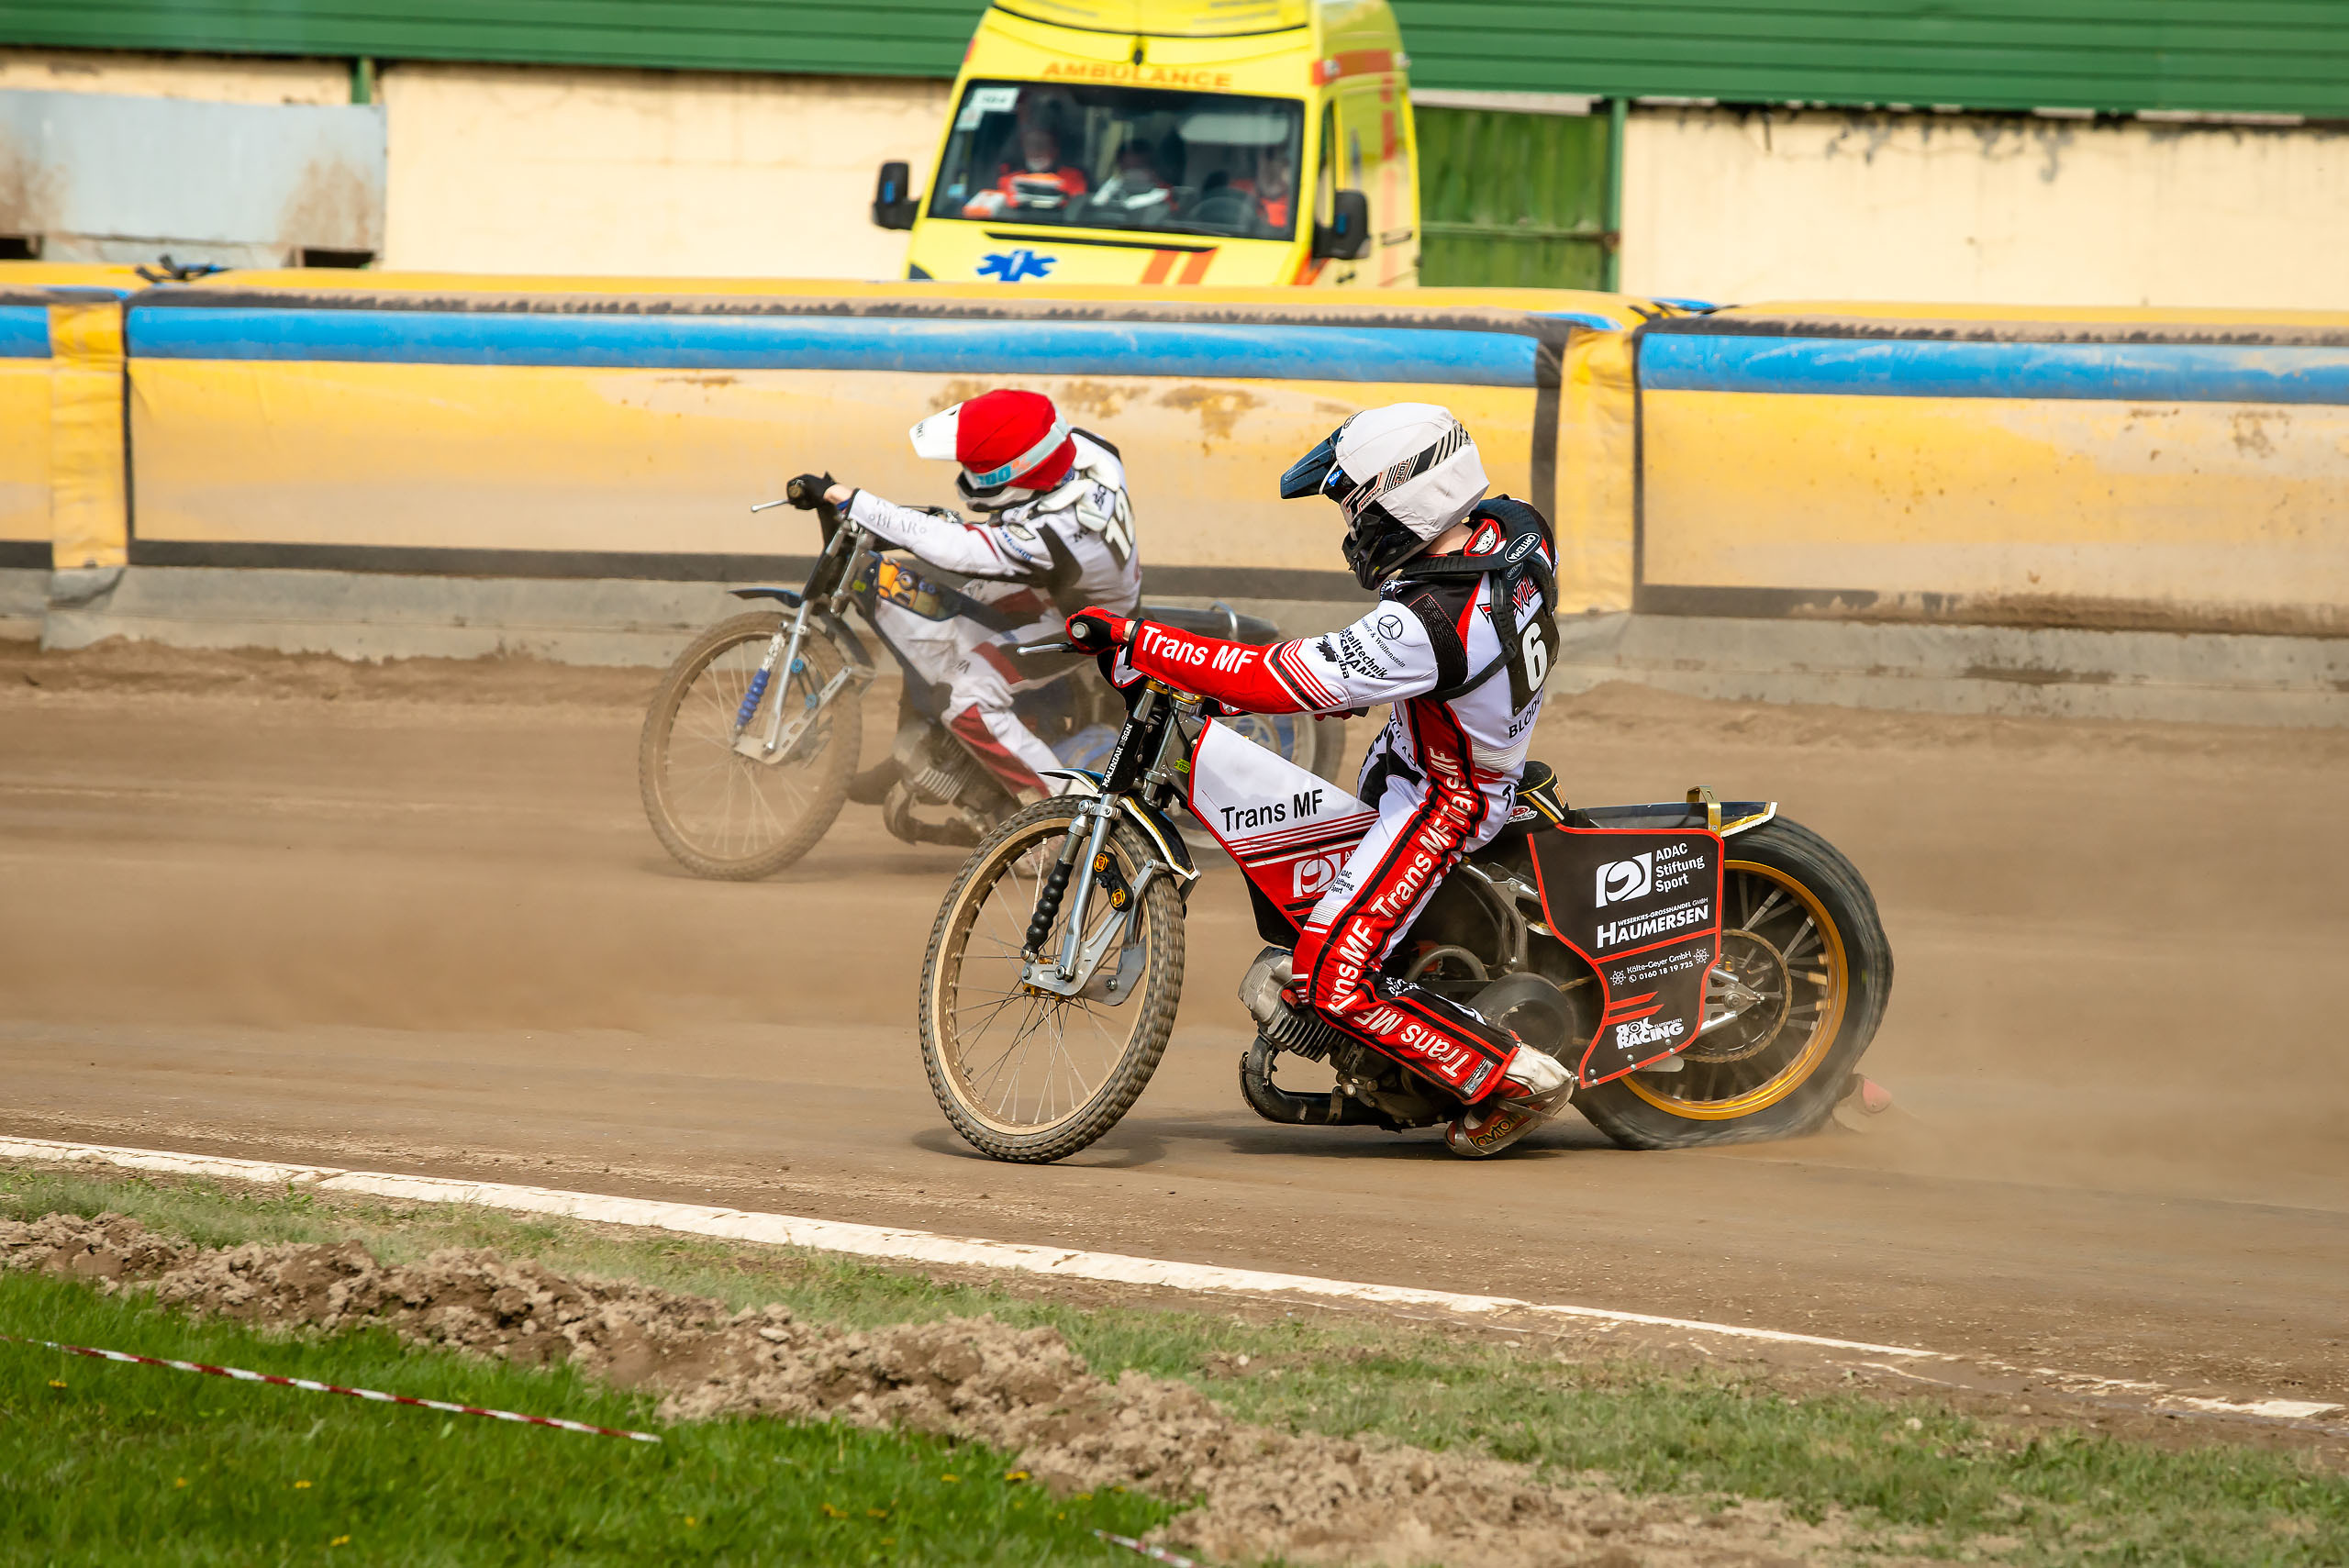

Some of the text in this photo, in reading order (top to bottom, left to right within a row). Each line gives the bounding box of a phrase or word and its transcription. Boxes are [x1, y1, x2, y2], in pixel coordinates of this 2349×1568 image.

[1042, 62, 1233, 87] AMBULANCE
[1508, 535, 1537, 560] ORTEMA
[1142, 625, 1259, 674] Trans MF
[1522, 622, 1548, 692] 6
[1508, 689, 1543, 740] BLÖDO
[1220, 789, 1323, 832] Trans MF
[1655, 842, 1688, 862] ADAC
[1371, 817, 1452, 918] Trans MF
[1655, 855, 1706, 878] Stiftung
[1655, 873, 1689, 893] Sport
[1597, 904, 1709, 949] HAUMERSEN
[1618, 901, 1692, 927] WESERKIES-GROSSHANDEL
[1340, 919, 1375, 968] MF
[1627, 951, 1692, 974] Kälte-Geyer GmbH
[1639, 971, 1658, 980] 0160
[1680, 961, 1694, 970] 725
[1353, 1006, 1404, 1035] MF
[1616, 1022, 1685, 1050] RACING
[1400, 1024, 1470, 1078] Trans
